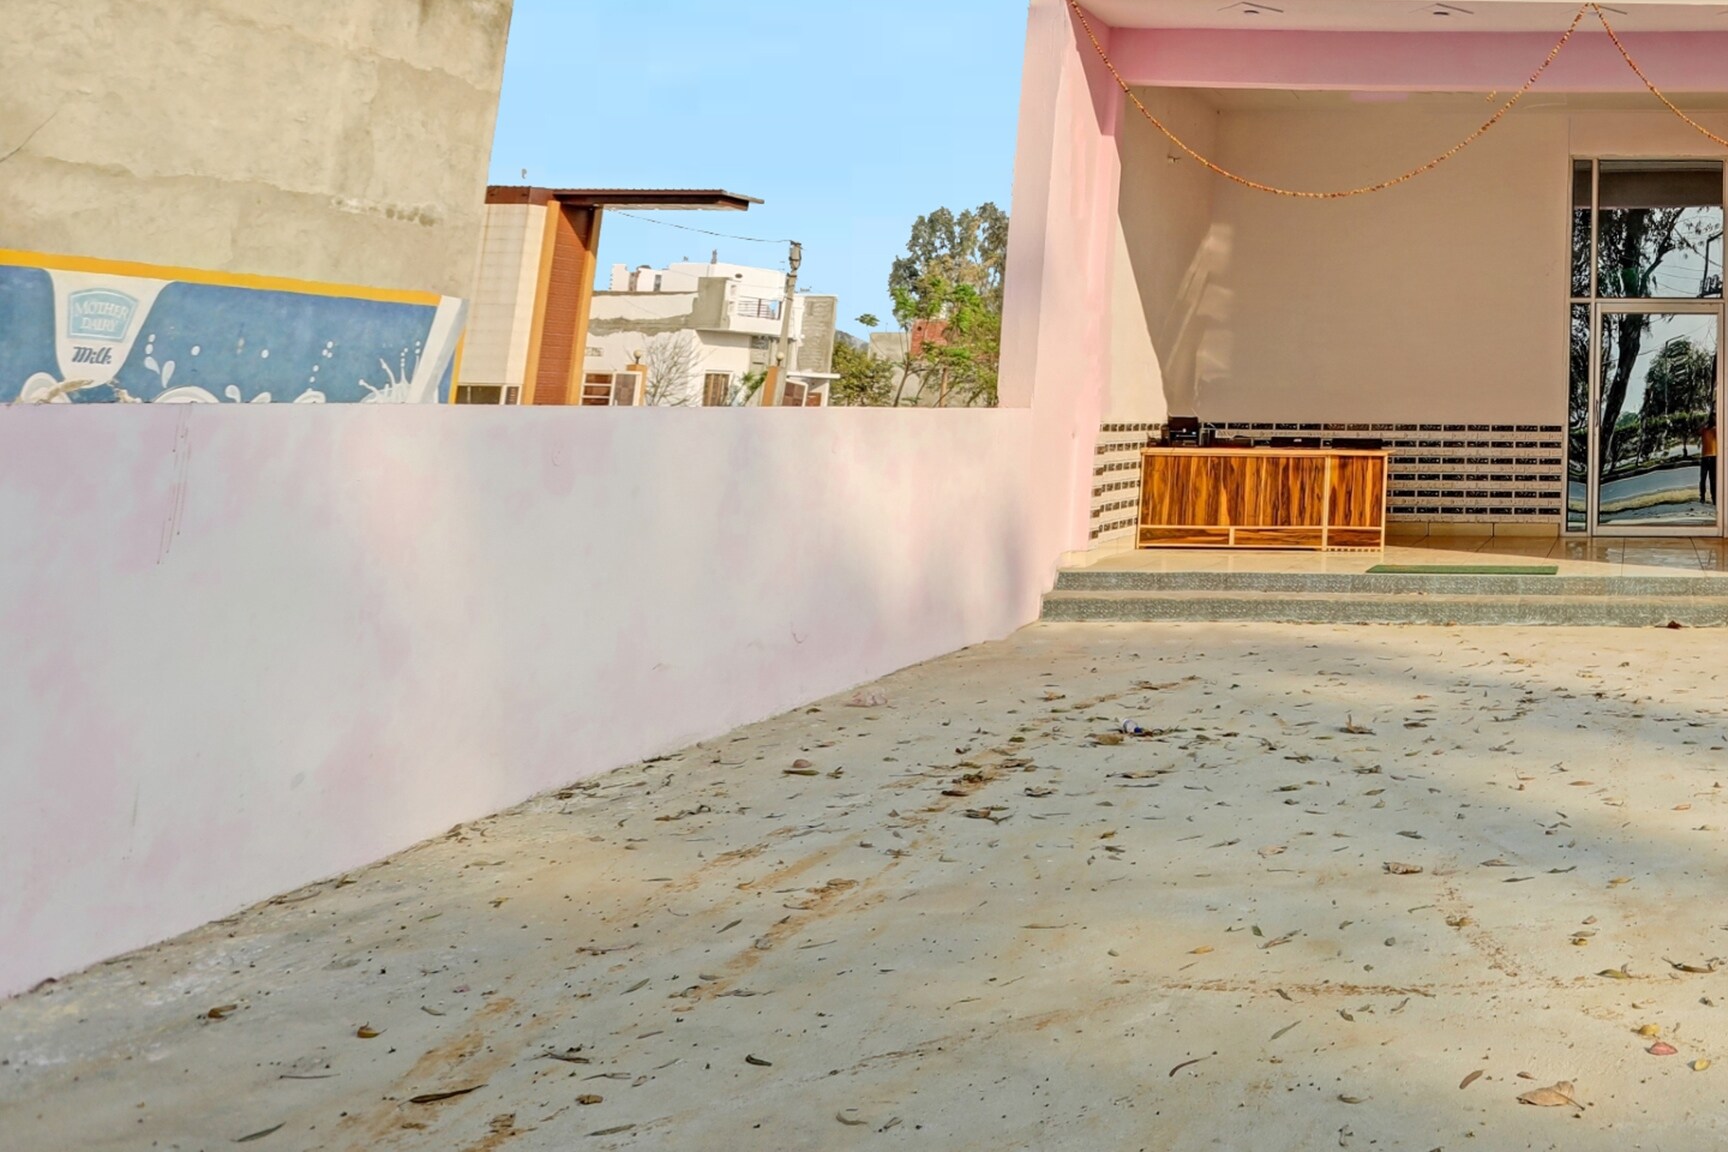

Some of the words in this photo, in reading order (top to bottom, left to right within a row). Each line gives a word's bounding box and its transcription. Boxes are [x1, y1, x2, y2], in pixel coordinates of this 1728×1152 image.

[74, 300, 129, 320] MOTHER
[80, 317, 118, 333] DAIRY
[71, 346, 113, 365] Milk
